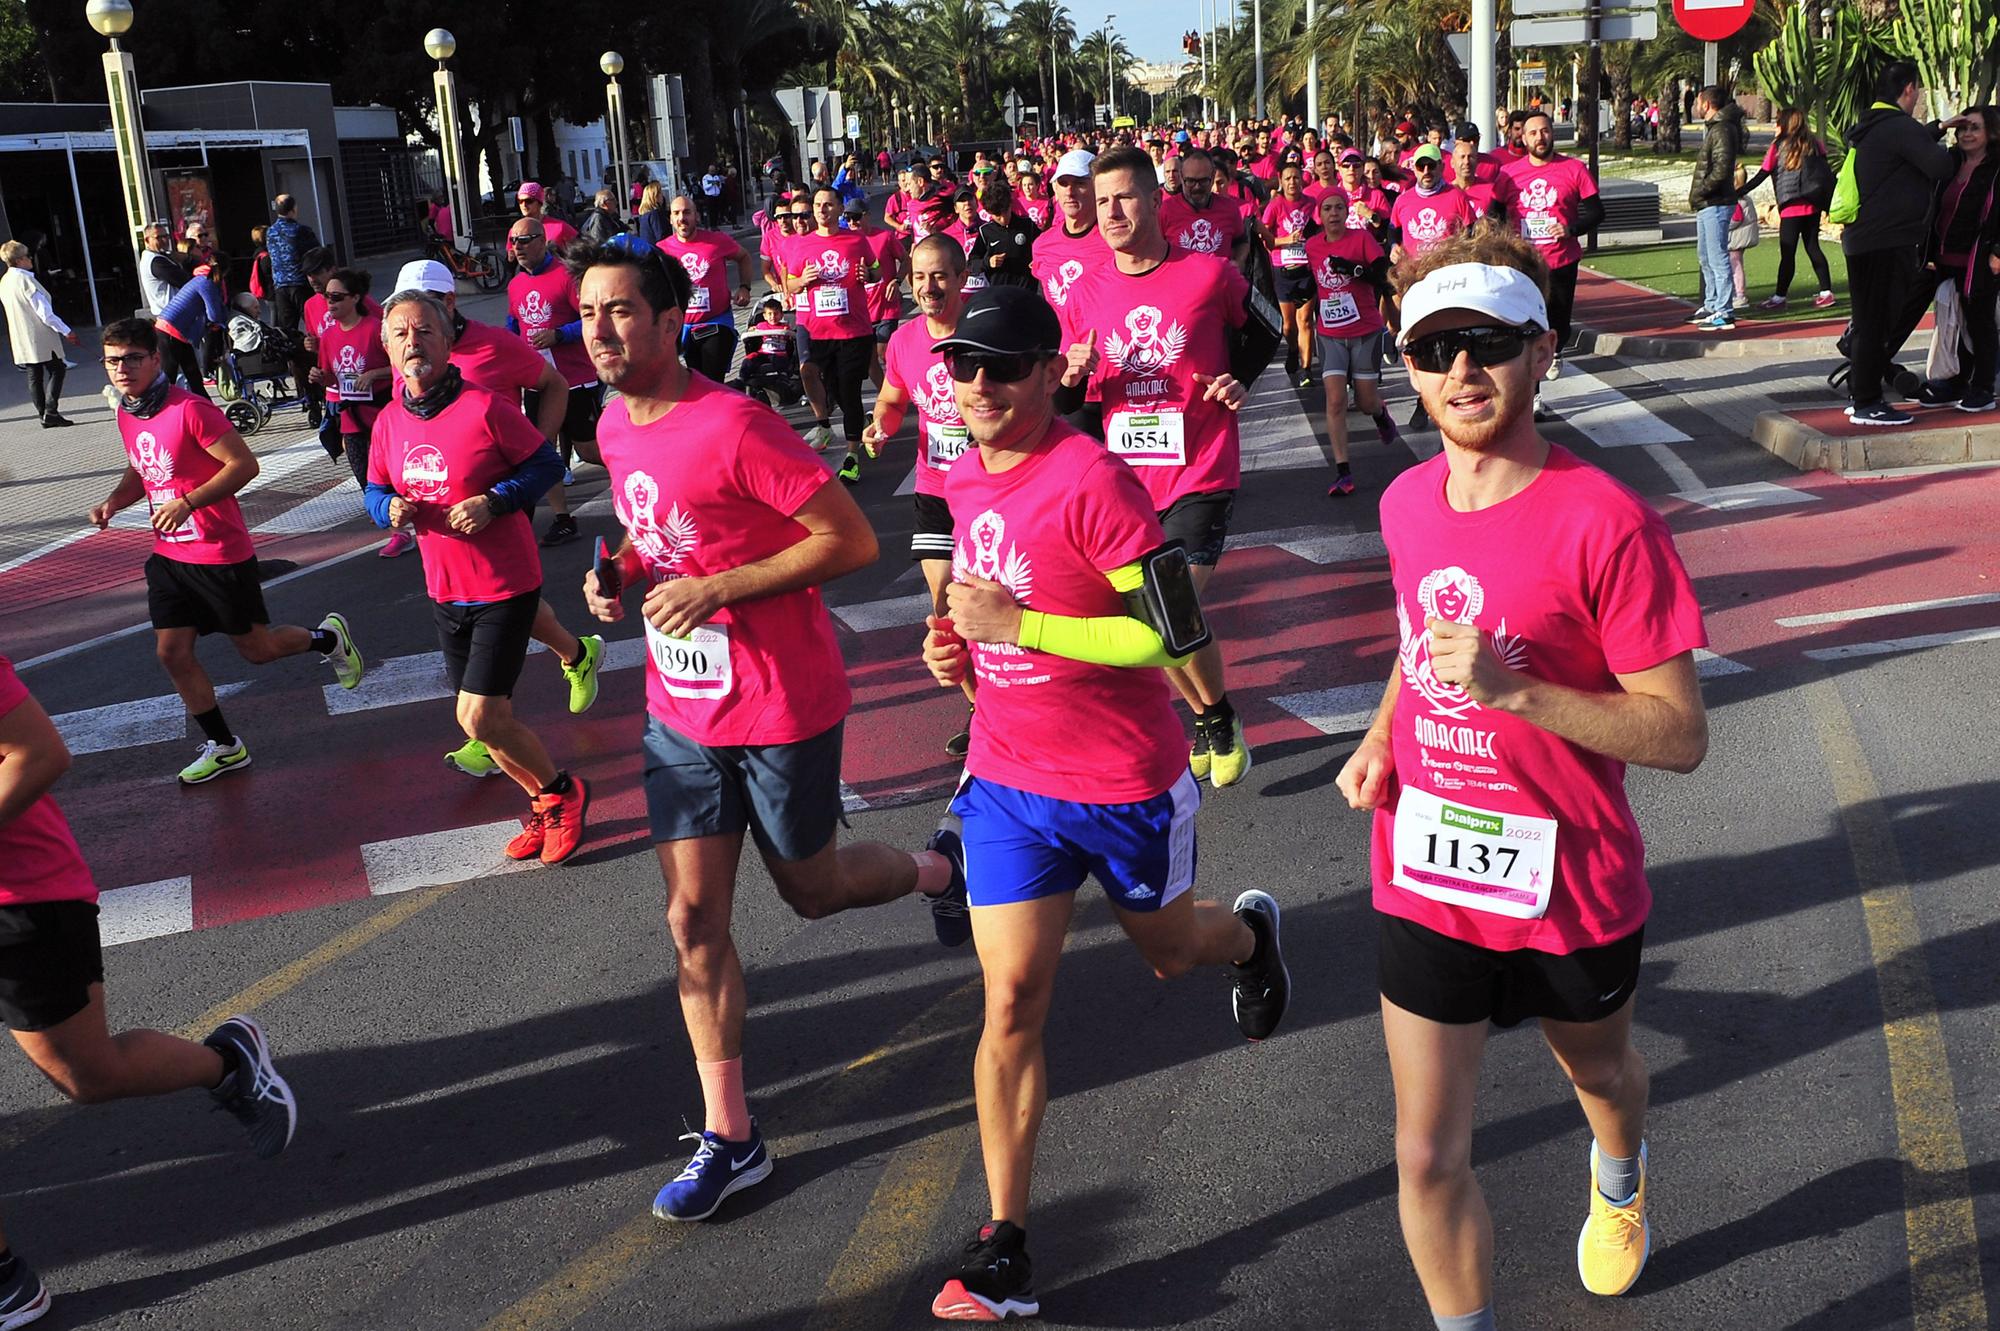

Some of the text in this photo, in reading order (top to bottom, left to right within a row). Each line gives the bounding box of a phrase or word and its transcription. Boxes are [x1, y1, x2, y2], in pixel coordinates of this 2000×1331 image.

[1436, 277, 1467, 294] HH
[819, 298, 842, 308] 4464
[1324, 305, 1350, 319] 0528
[936, 439, 966, 457] 046
[1122, 431, 1169, 449] 0554
[693, 634, 719, 643] 2022
[655, 640, 708, 675] 0390
[1414, 715, 1498, 760] AMACMEC
[1444, 810, 1500, 832] Dialprix
[1505, 827, 1542, 841] 2022
[1423, 832, 1521, 879] 1137
